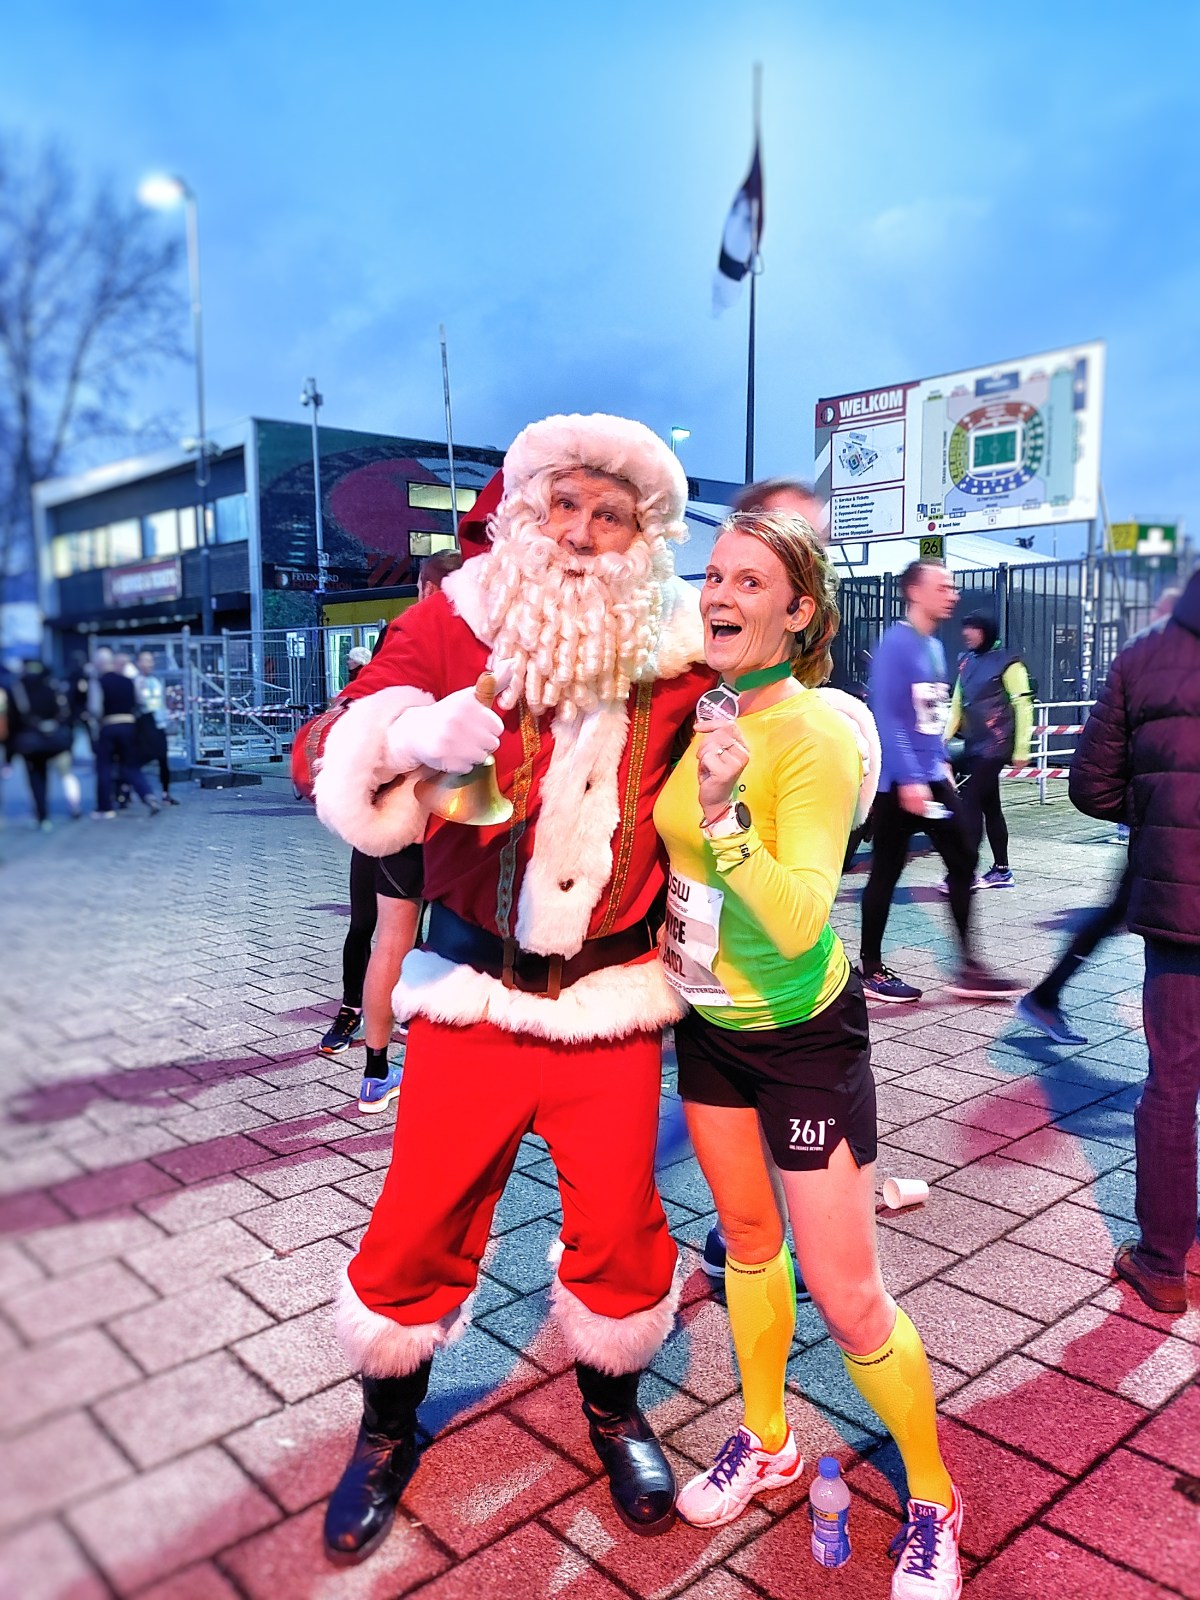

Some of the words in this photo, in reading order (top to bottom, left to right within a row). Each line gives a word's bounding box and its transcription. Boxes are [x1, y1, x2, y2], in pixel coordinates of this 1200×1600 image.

[839, 389, 903, 418] WELKOM
[923, 541, 939, 555] 26
[292, 572, 339, 582] FEYENRD
